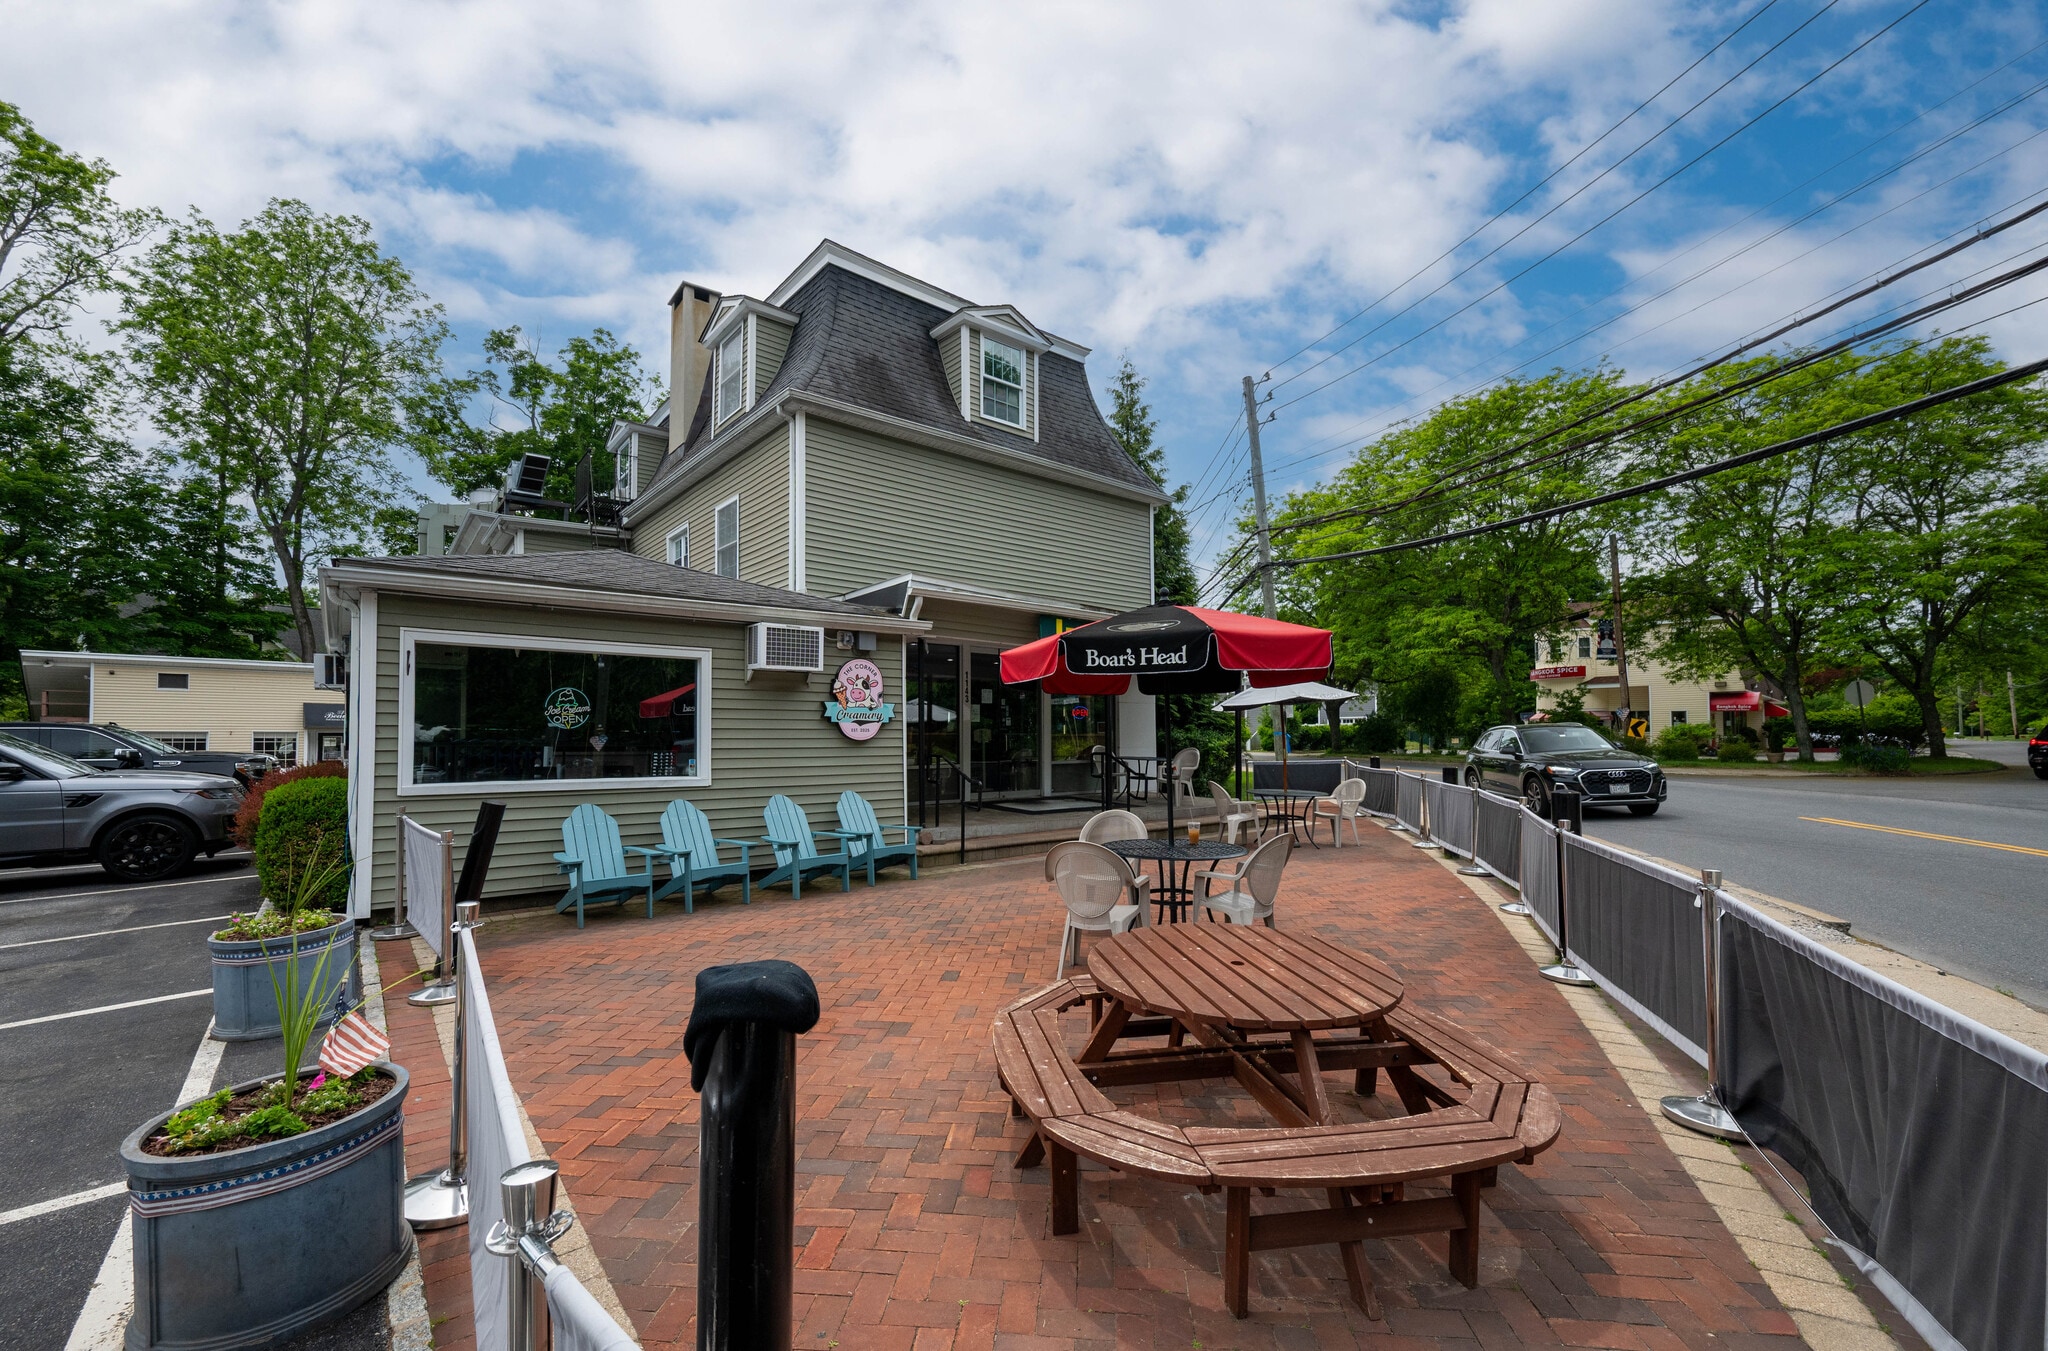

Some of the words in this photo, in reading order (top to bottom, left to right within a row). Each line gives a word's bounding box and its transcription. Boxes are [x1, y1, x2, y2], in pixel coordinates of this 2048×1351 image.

[1085, 648, 1136, 668] Boar's
[1140, 645, 1188, 666] Head
[843, 666, 853, 676] THE
[854, 663, 878, 677] CORNER
[544, 705, 561, 715] Ice
[562, 705, 591, 714] Cream
[1071, 709, 1089, 717] OPEN
[553, 715, 583, 724] OPEN
[836, 709, 885, 724] Creamery
